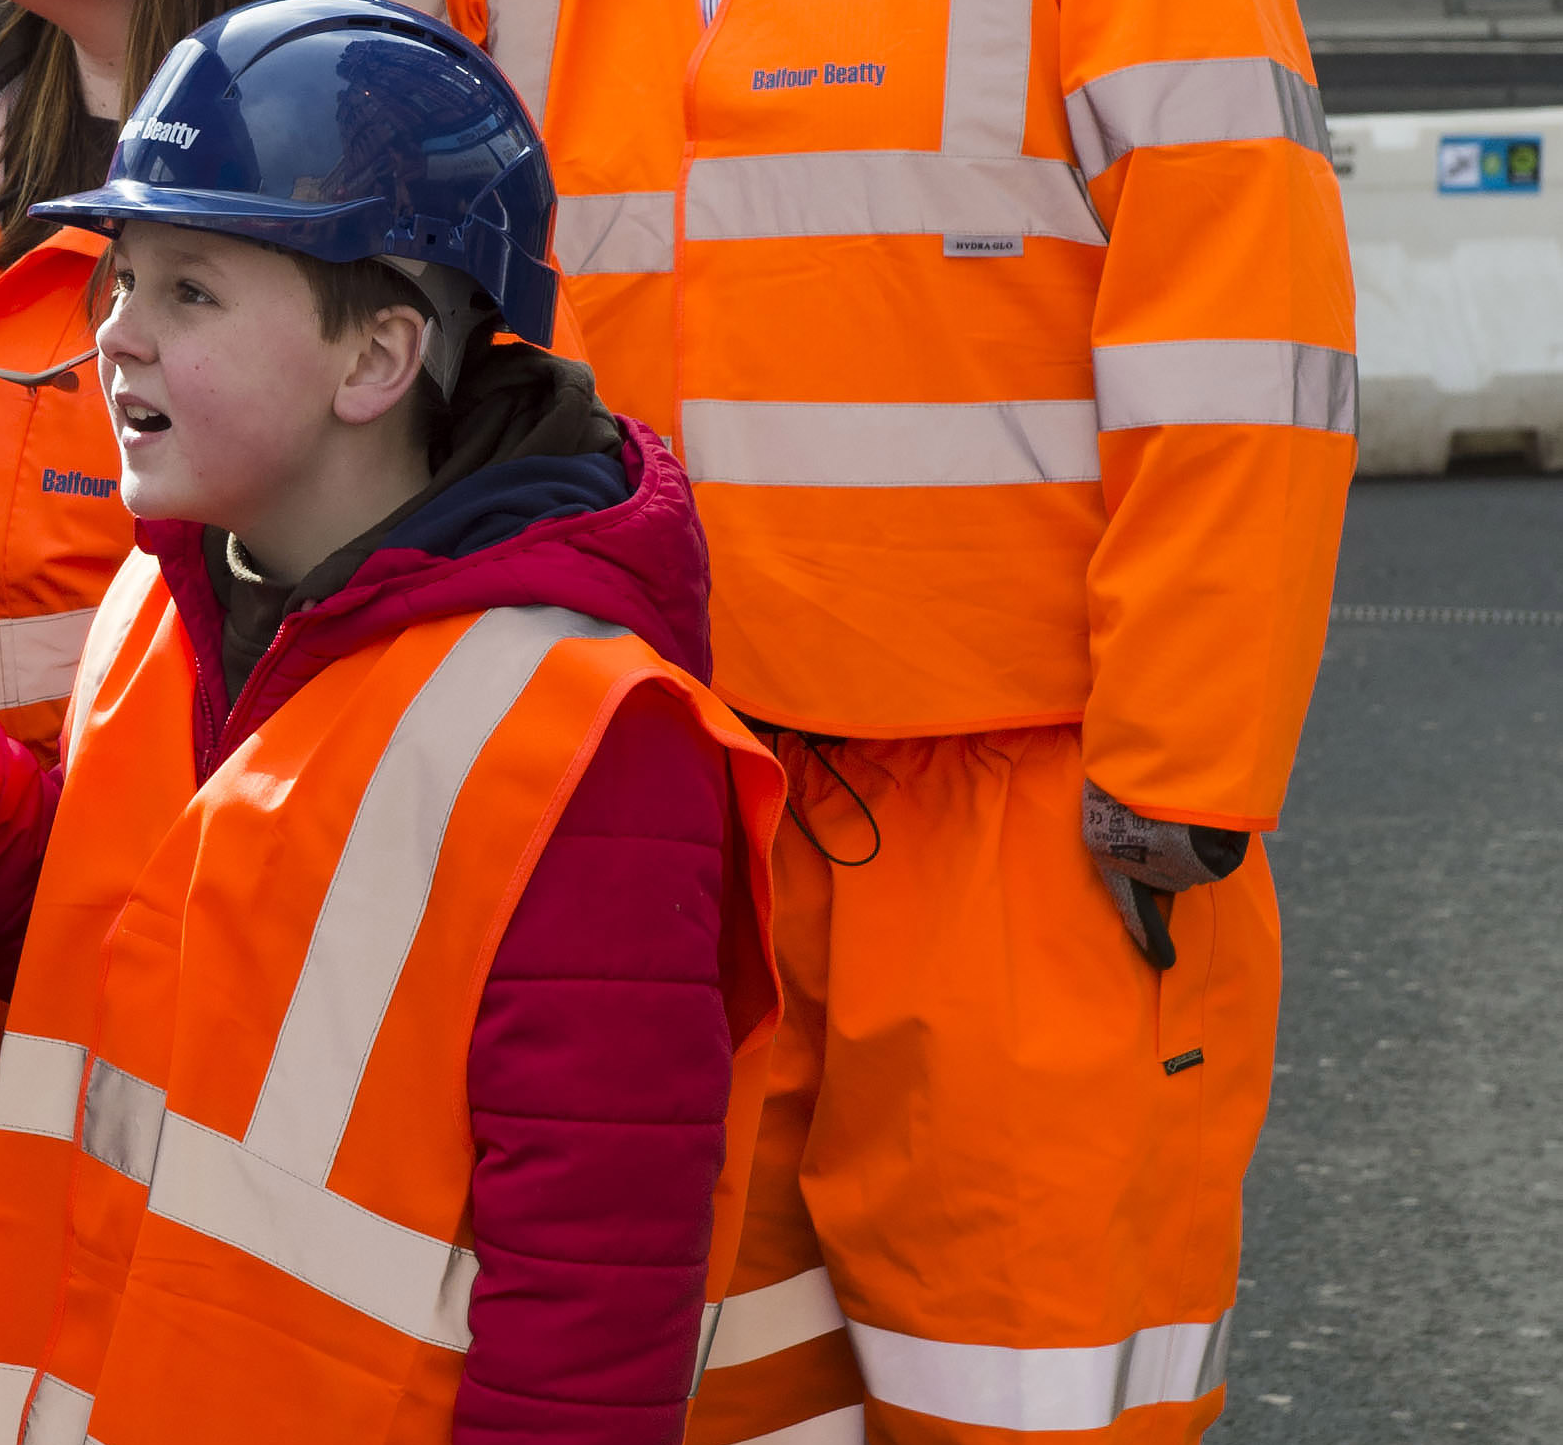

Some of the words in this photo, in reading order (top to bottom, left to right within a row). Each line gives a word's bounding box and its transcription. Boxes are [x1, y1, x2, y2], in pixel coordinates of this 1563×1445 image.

[752, 67, 818, 91] Balfour
[824, 62, 886, 86] Beatty
[142, 116, 201, 150] Beatty
[992, 240, 1014, 251] GLO
[42, 468, 117, 498] Balfour
